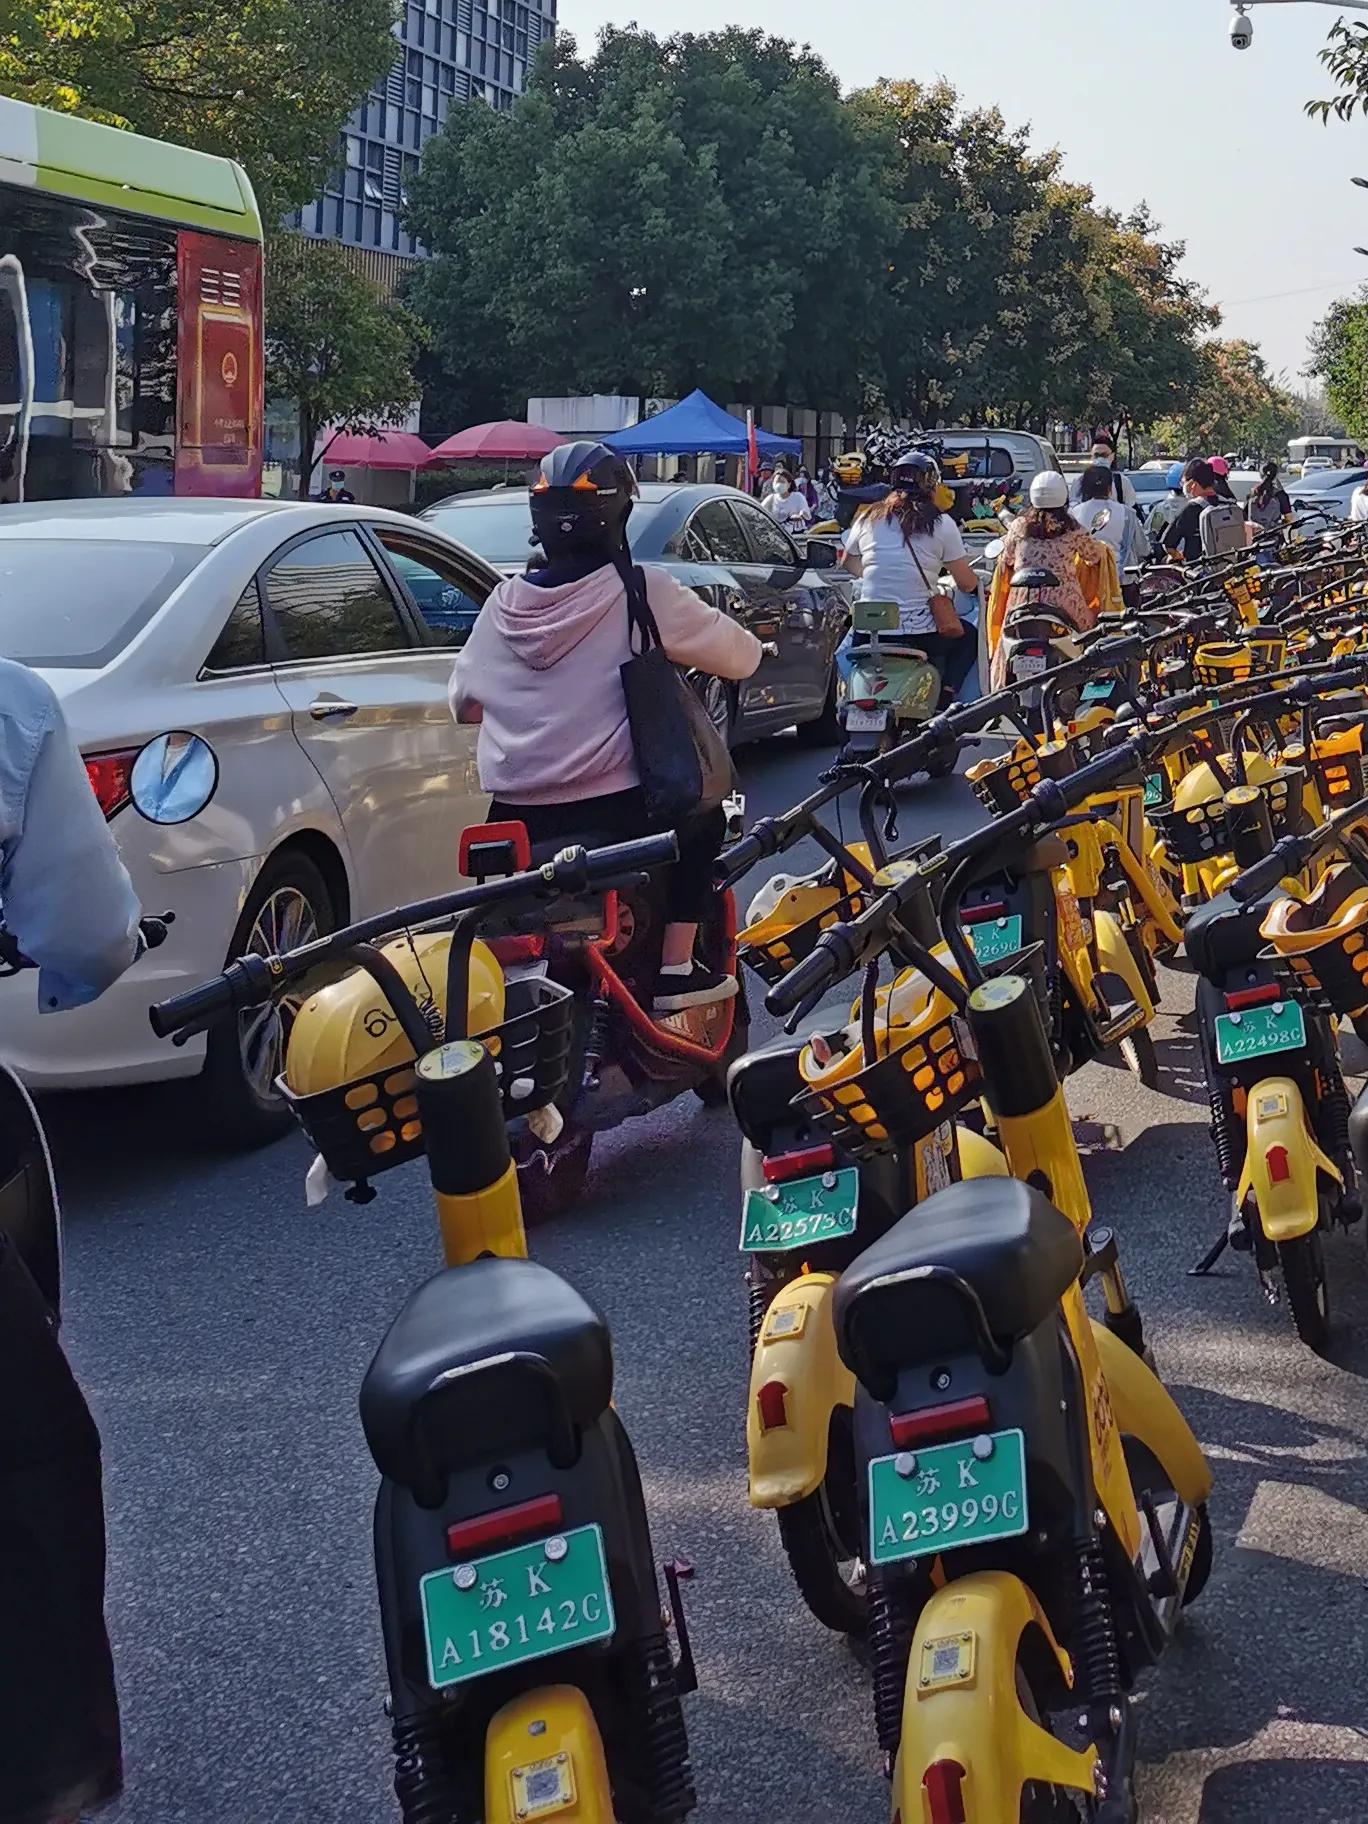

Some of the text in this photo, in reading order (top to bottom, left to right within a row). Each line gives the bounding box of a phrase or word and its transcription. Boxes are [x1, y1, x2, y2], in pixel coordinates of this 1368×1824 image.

[1264, 1014, 1278, 1029] K
[1222, 1027, 1301, 1057] A22498G
[809, 1188, 825, 1209] K
[914, 1457, 979, 1497] 苏 K
[877, 1489, 1019, 1547] A23999G
[479, 1561, 552, 1612] 苏 K
[437, 1592, 601, 1670] A18142G
